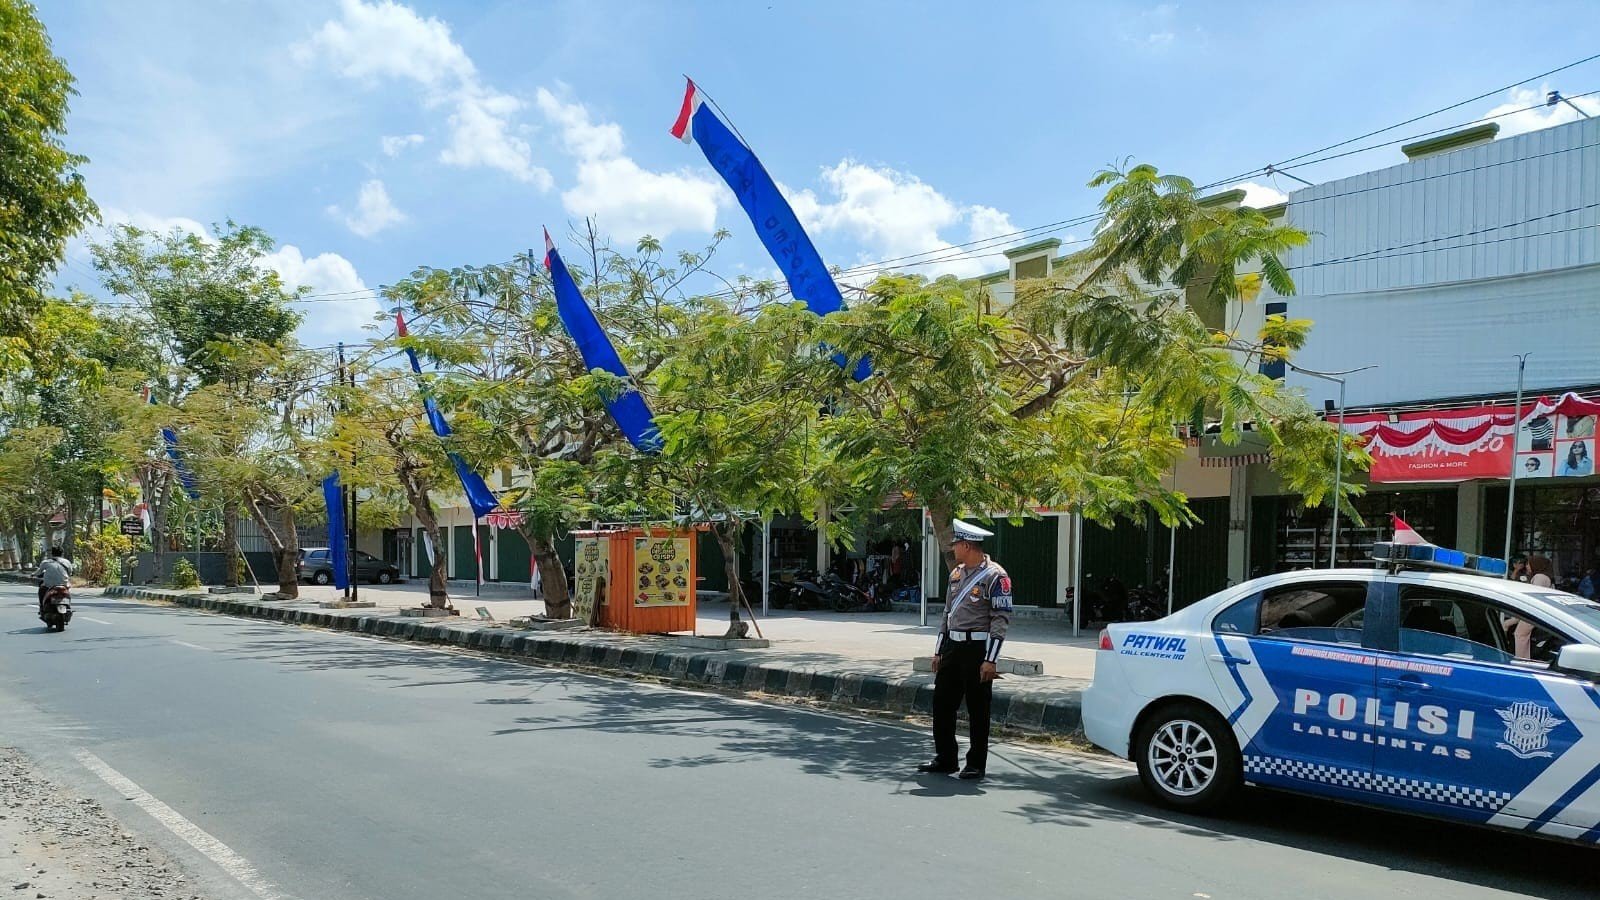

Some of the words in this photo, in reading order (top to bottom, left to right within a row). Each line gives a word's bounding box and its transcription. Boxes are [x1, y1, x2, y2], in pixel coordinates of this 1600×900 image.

[1408, 462, 1439, 470] FASHION
[1122, 634, 1187, 653] PATWAL
[1140, 651, 1171, 659] CENTER
[1293, 688, 1475, 740] POLISI
[1293, 722, 1472, 760] LALULINTAS
